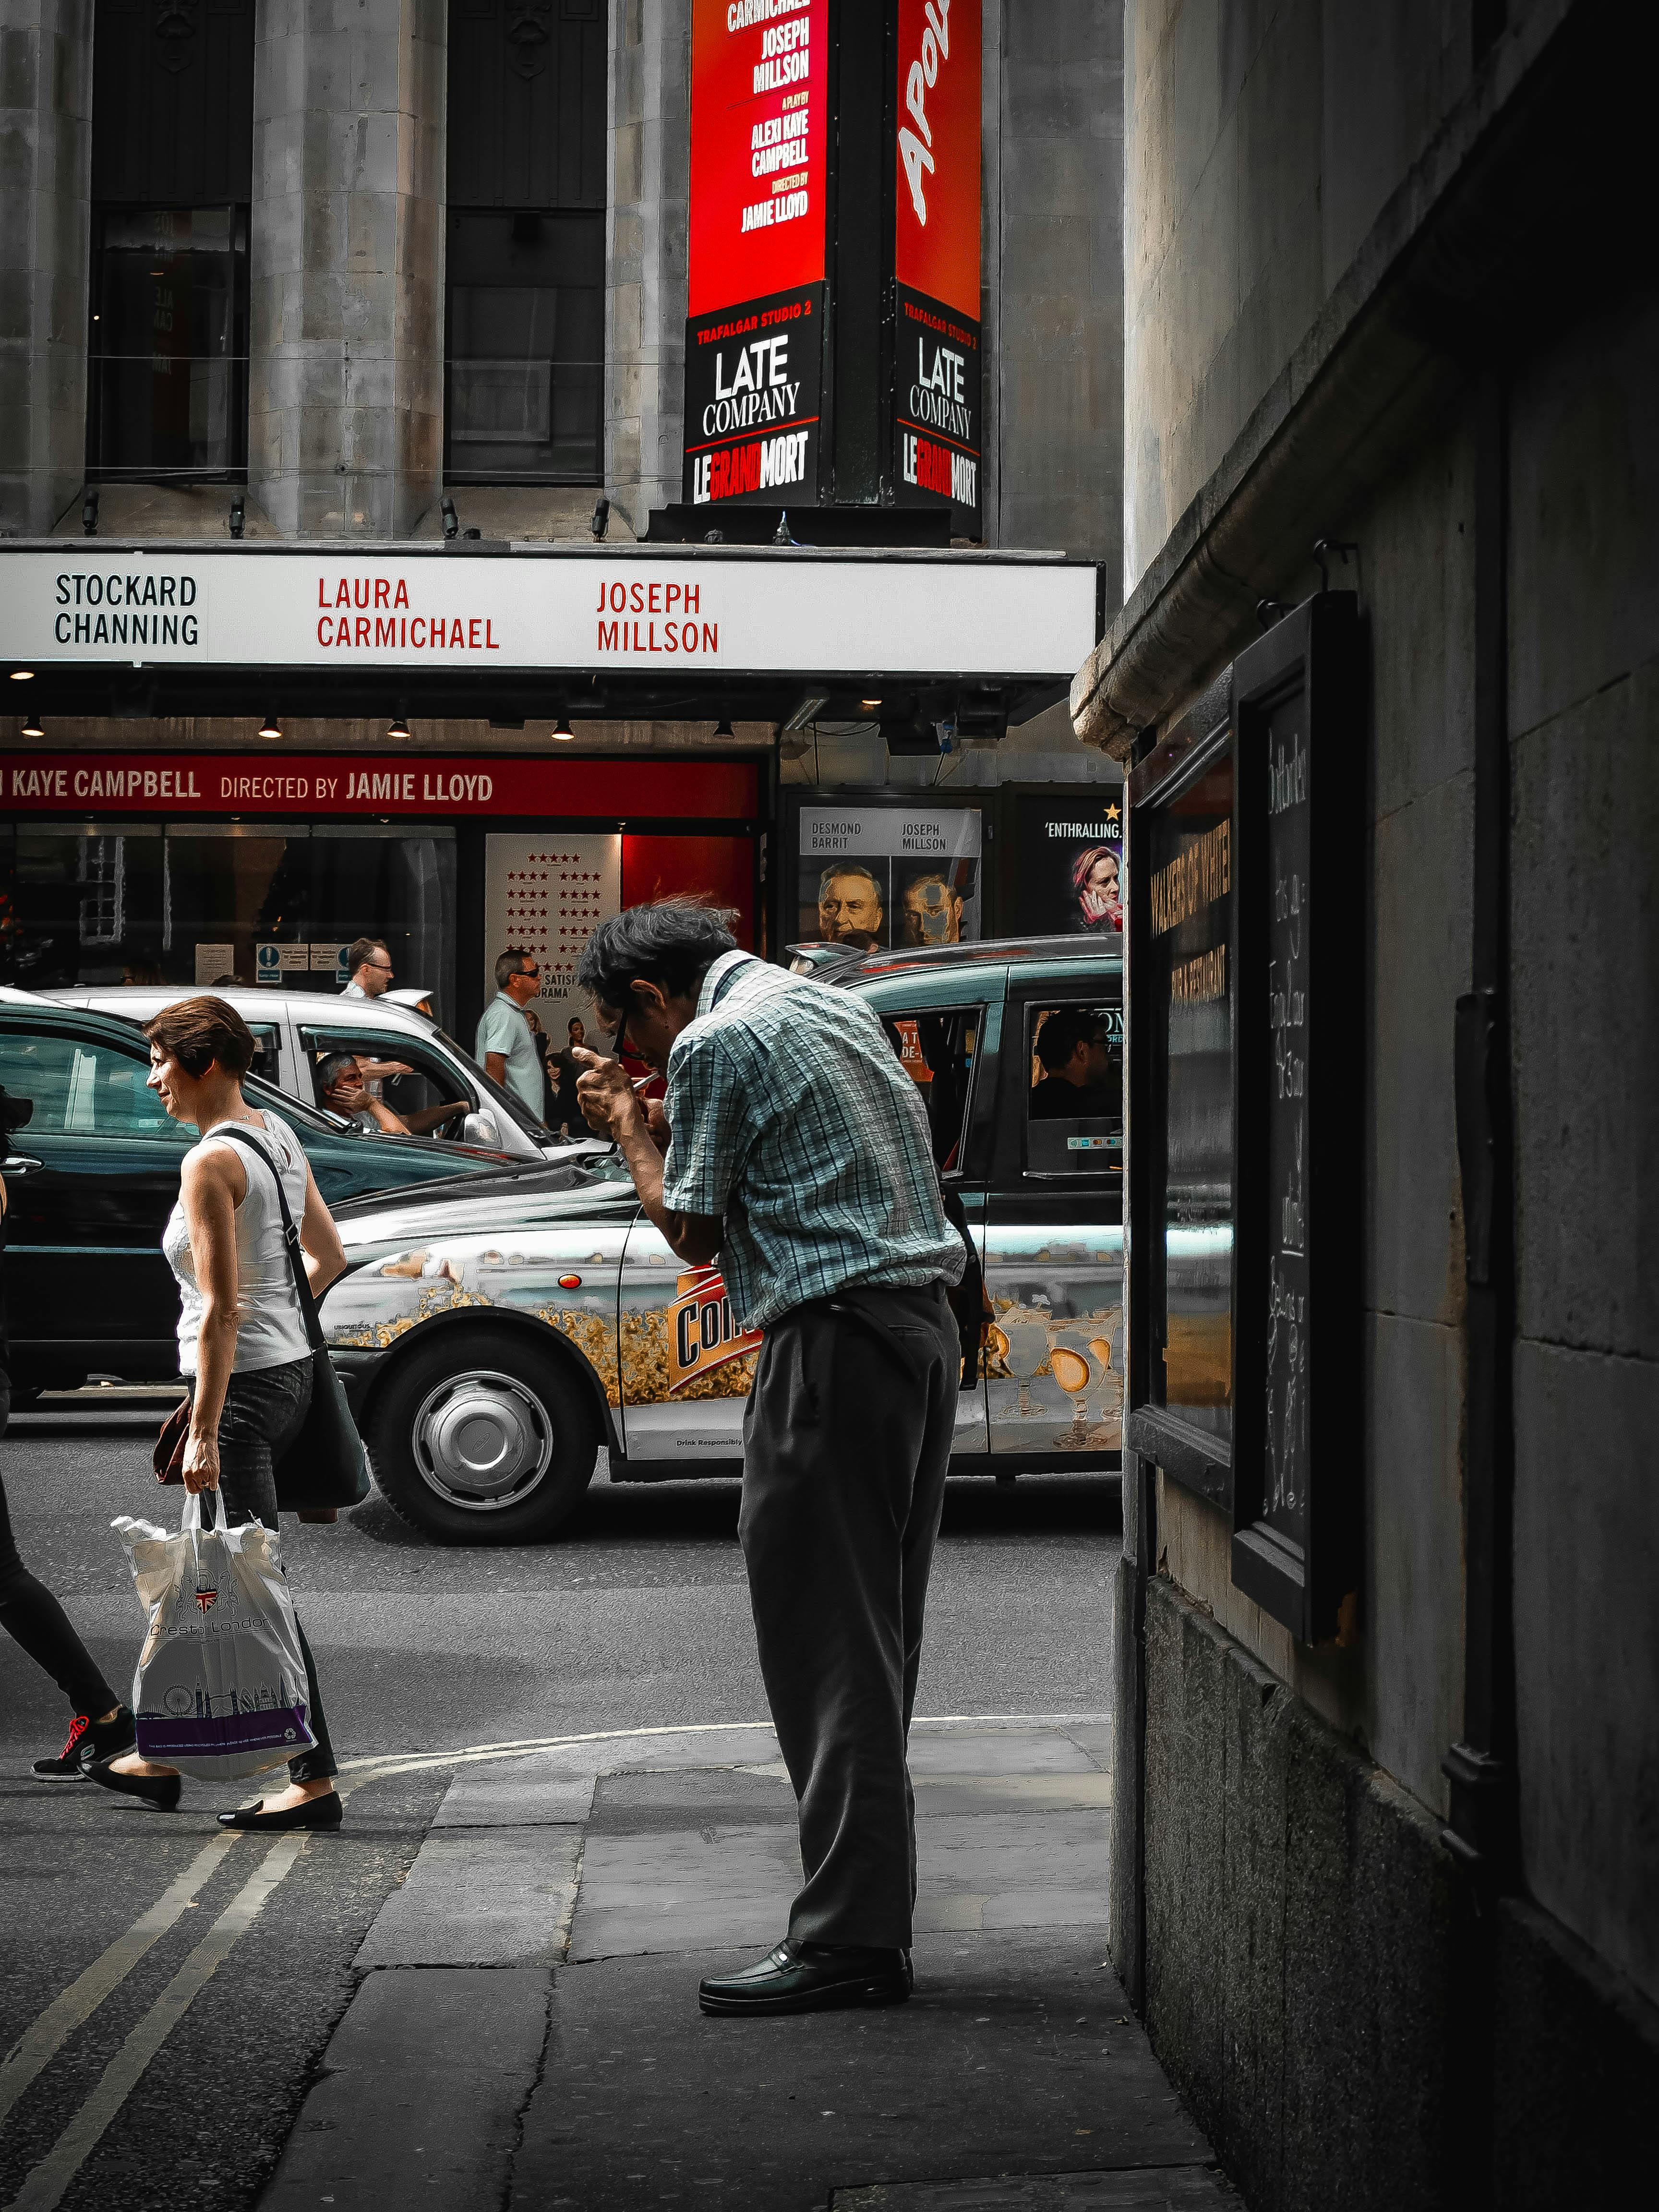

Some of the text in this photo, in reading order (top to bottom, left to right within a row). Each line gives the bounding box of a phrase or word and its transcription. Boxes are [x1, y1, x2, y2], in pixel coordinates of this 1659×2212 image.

[761, 17, 810, 60] JOSEPH
[753, 48, 809, 94] MILLSON
[782, 90, 809, 111] A PLAY BY
[898, 0, 950, 226] APOL
[751, 108, 809, 150] ALEXI KAYE
[752, 137, 809, 177] CAMPBELL
[772, 171, 809, 195] DIRECTED BY
[741, 190, 808, 233] JAMIE LLOYD
[697, 300, 811, 345] TRAFALGAR STUDIO 2
[904, 301, 947, 334] TRAFALGAR
[948, 323, 971, 347] STUDIO
[715, 334, 788, 400] LATE
[919, 337, 964, 404] LATE
[703, 382, 800, 436] COMPANY
[910, 385, 971, 439] COMPANY
[55, 574, 197, 607] STOCKARD
[318, 578, 409, 610] LAURA
[596, 582, 700, 614] JOSEPH
[55, 613, 198, 646] CHANNING
[317, 616, 500, 649] CARMICHAEL
[598, 620, 719, 653] MILLSON
[12, 770, 68, 796] KAYE
[74, 770, 201, 797] CAMPBELL
[221, 777, 308, 798] DIRECTED
[316, 778, 338, 798] BY
[346, 772, 415, 800] JAMIE
[423, 774, 493, 801] LLOYD
[812, 822, 862, 835] DESMOND
[812, 837, 849, 849] BARRIT
[901, 823, 940, 836] JOSEPH
[902, 837, 946, 850] MILLSON
[1150, 853, 1185, 940] WALKERS
[1188, 842, 1200, 916] OF
[544, 974, 577, 986] SATISF
[902, 1046, 923, 1058] DE-
[911, 1032, 918, 1044] T
[697, 1438, 743, 1447] Responsibly
[211, 1616, 272, 1633] London
